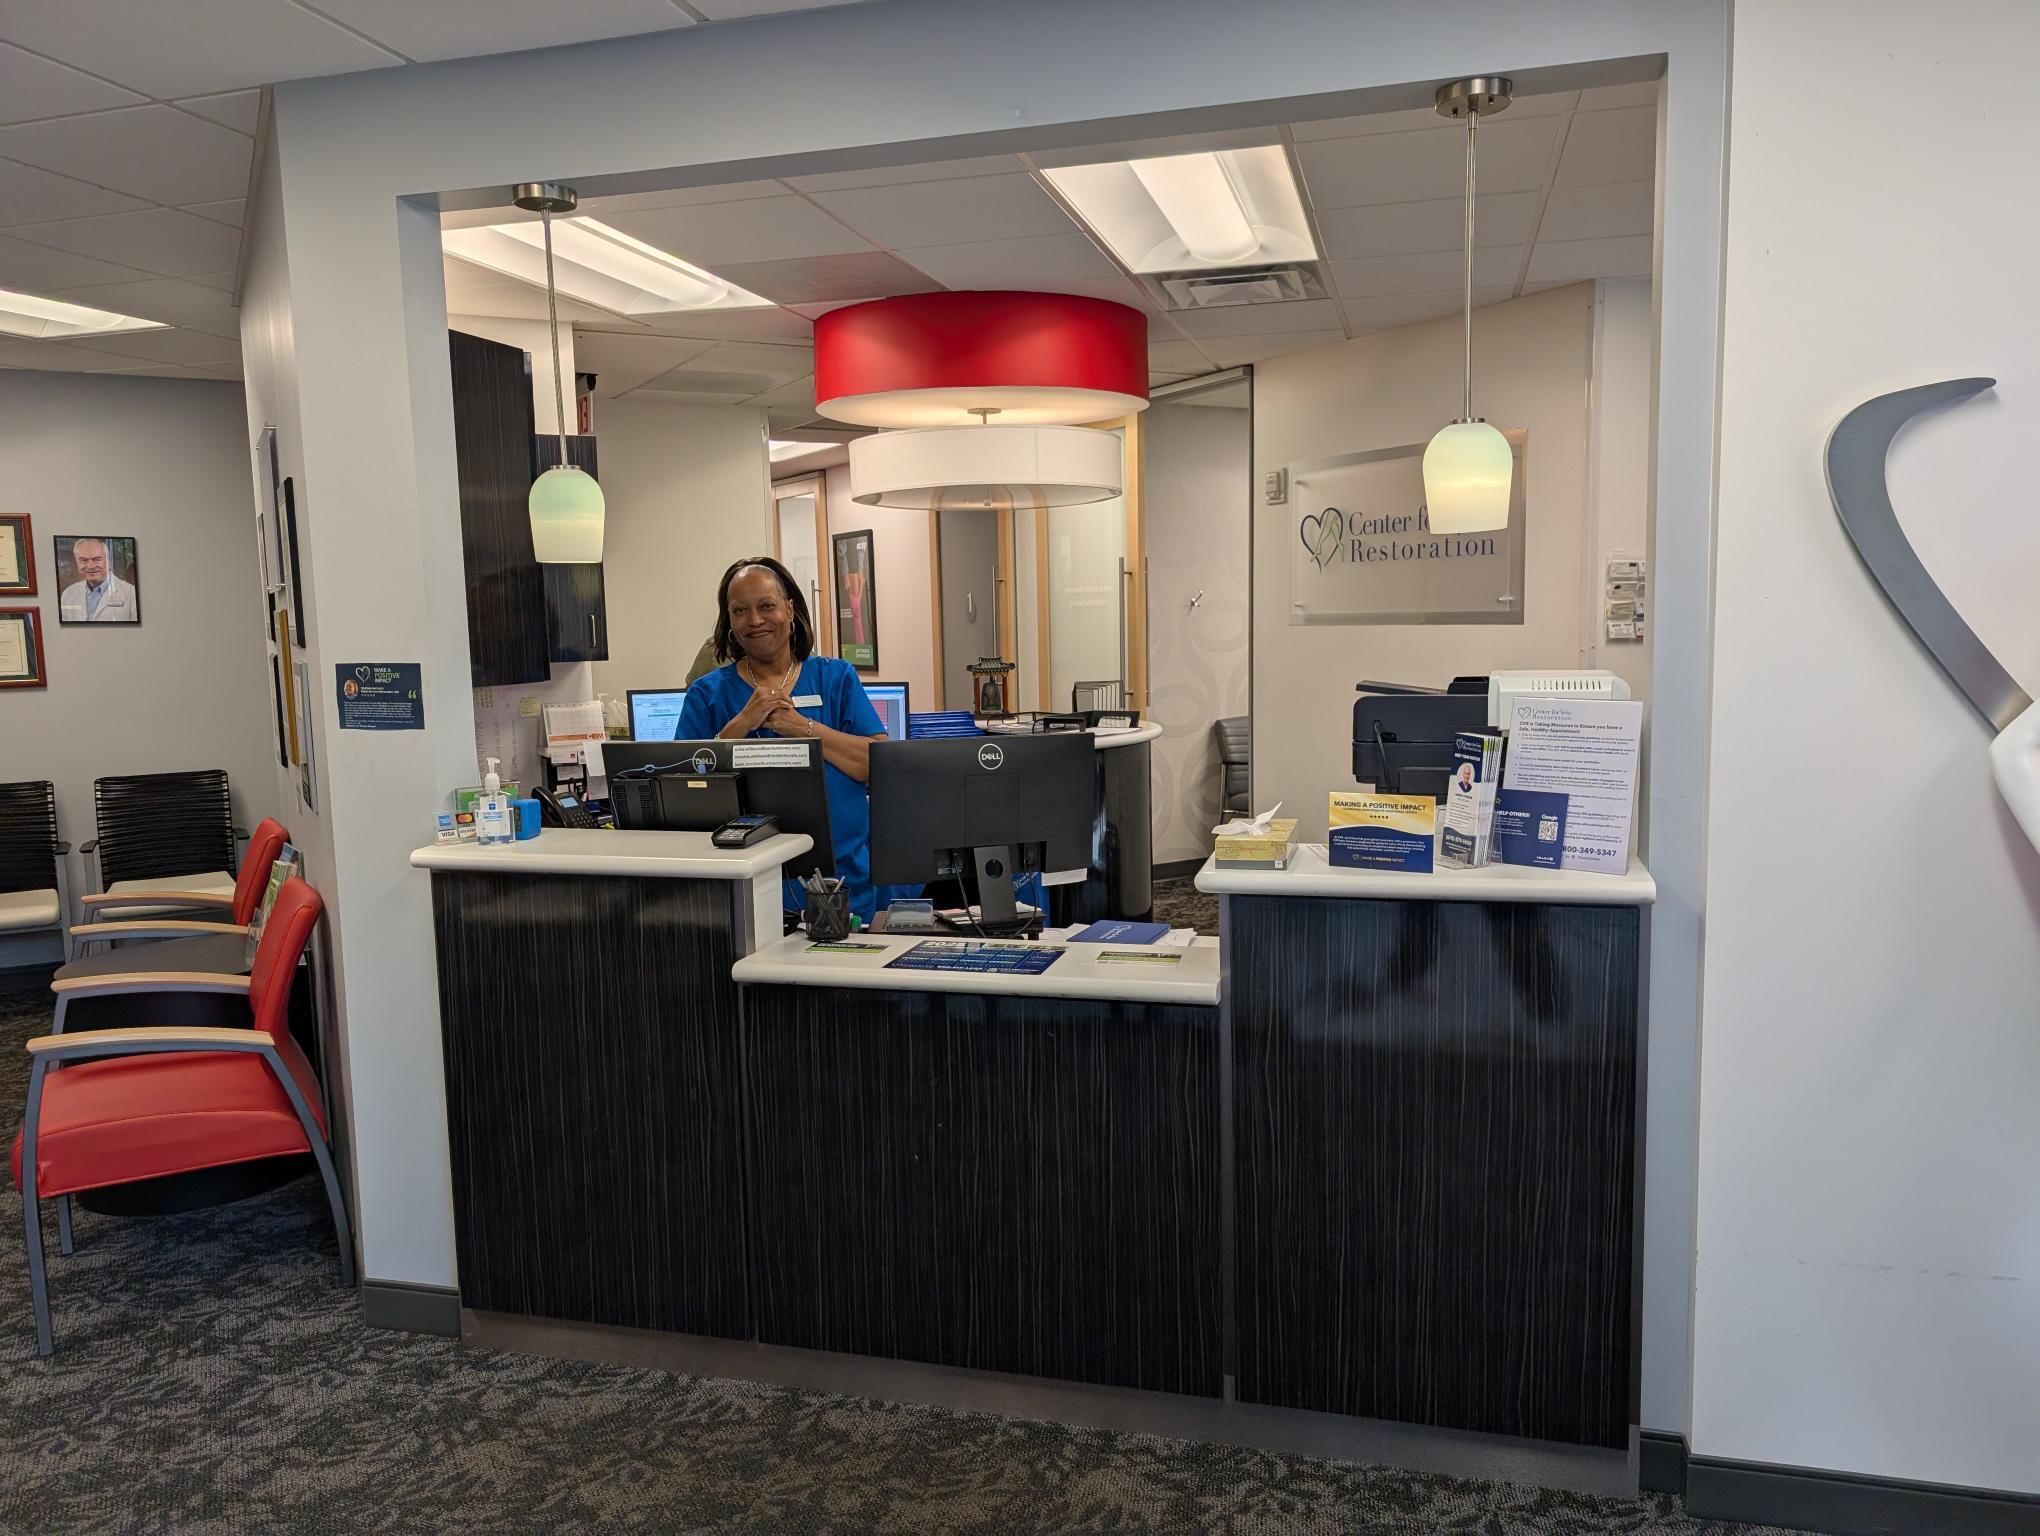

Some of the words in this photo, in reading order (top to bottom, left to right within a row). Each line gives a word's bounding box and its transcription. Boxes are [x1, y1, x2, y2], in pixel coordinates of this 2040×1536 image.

[1348, 511, 1412, 537] Center
[1350, 537, 1496, 563] Restoration
[981, 753, 1001, 761] DELL
[1333, 800, 1362, 808] MAKING
[1368, 802, 1399, 810] POSITIVE
[1562, 845, 1617, 857] 800-349-5347
